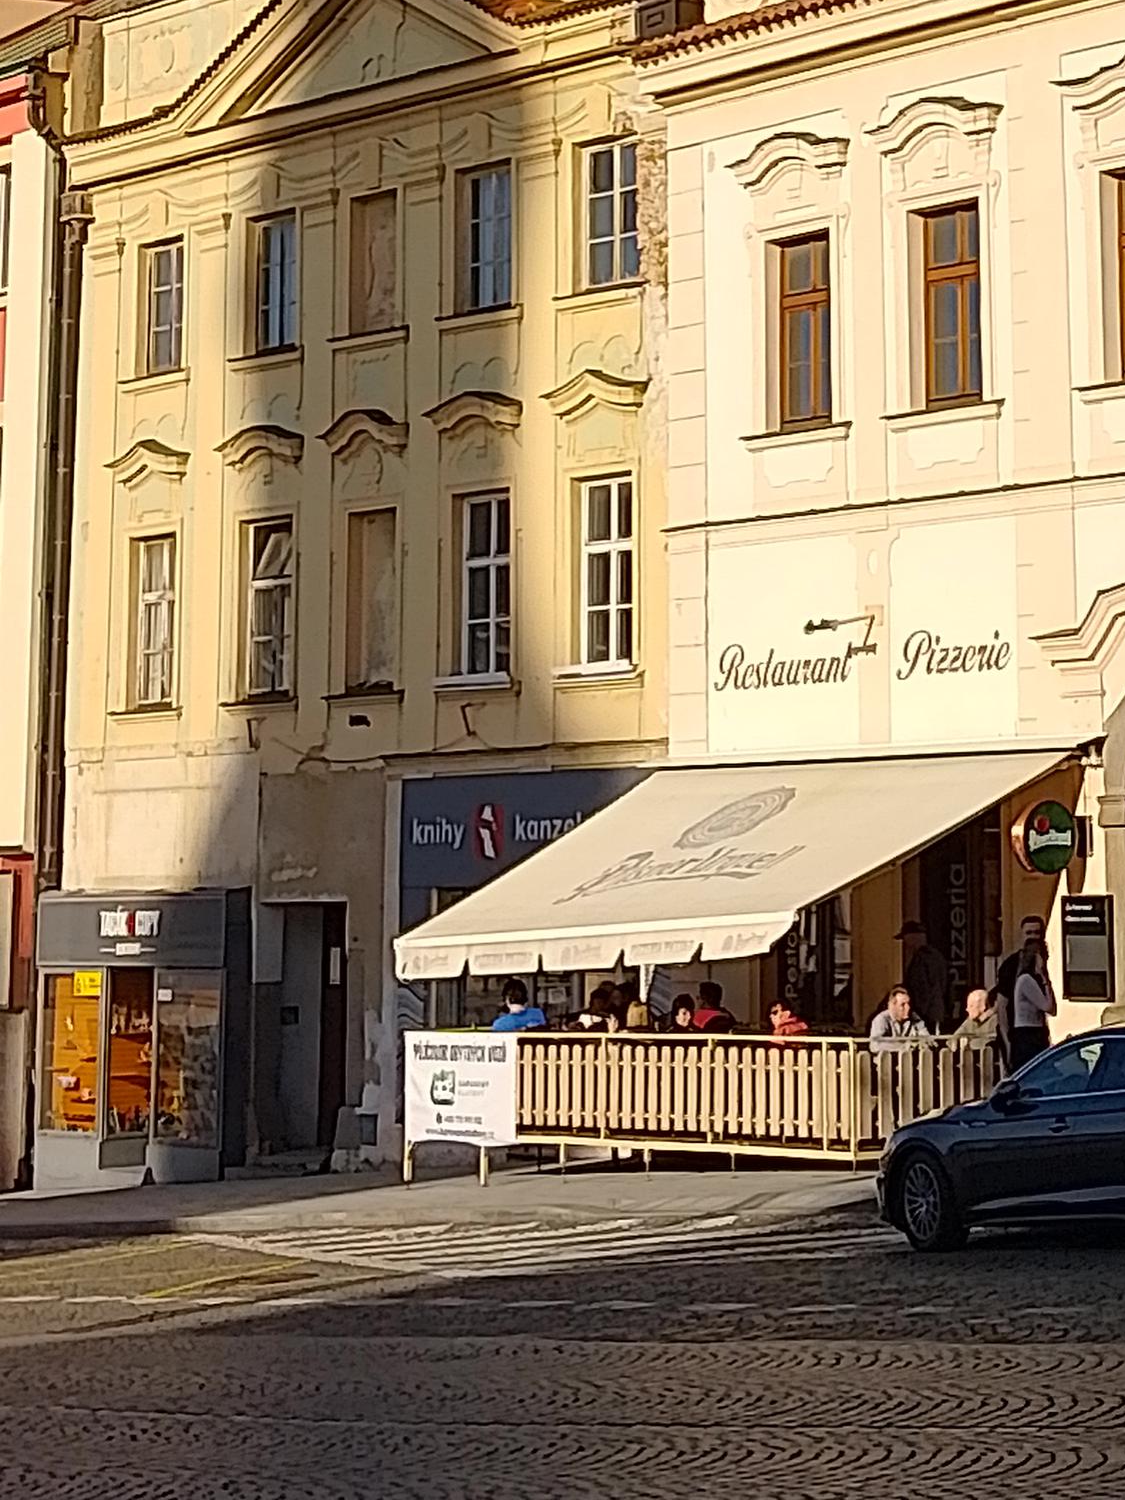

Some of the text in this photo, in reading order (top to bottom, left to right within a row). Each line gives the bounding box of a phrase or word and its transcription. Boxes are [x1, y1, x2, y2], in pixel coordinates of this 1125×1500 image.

[714, 630, 1013, 691] Restaurant Pizzerie
[411, 816, 466, 849] knihy
